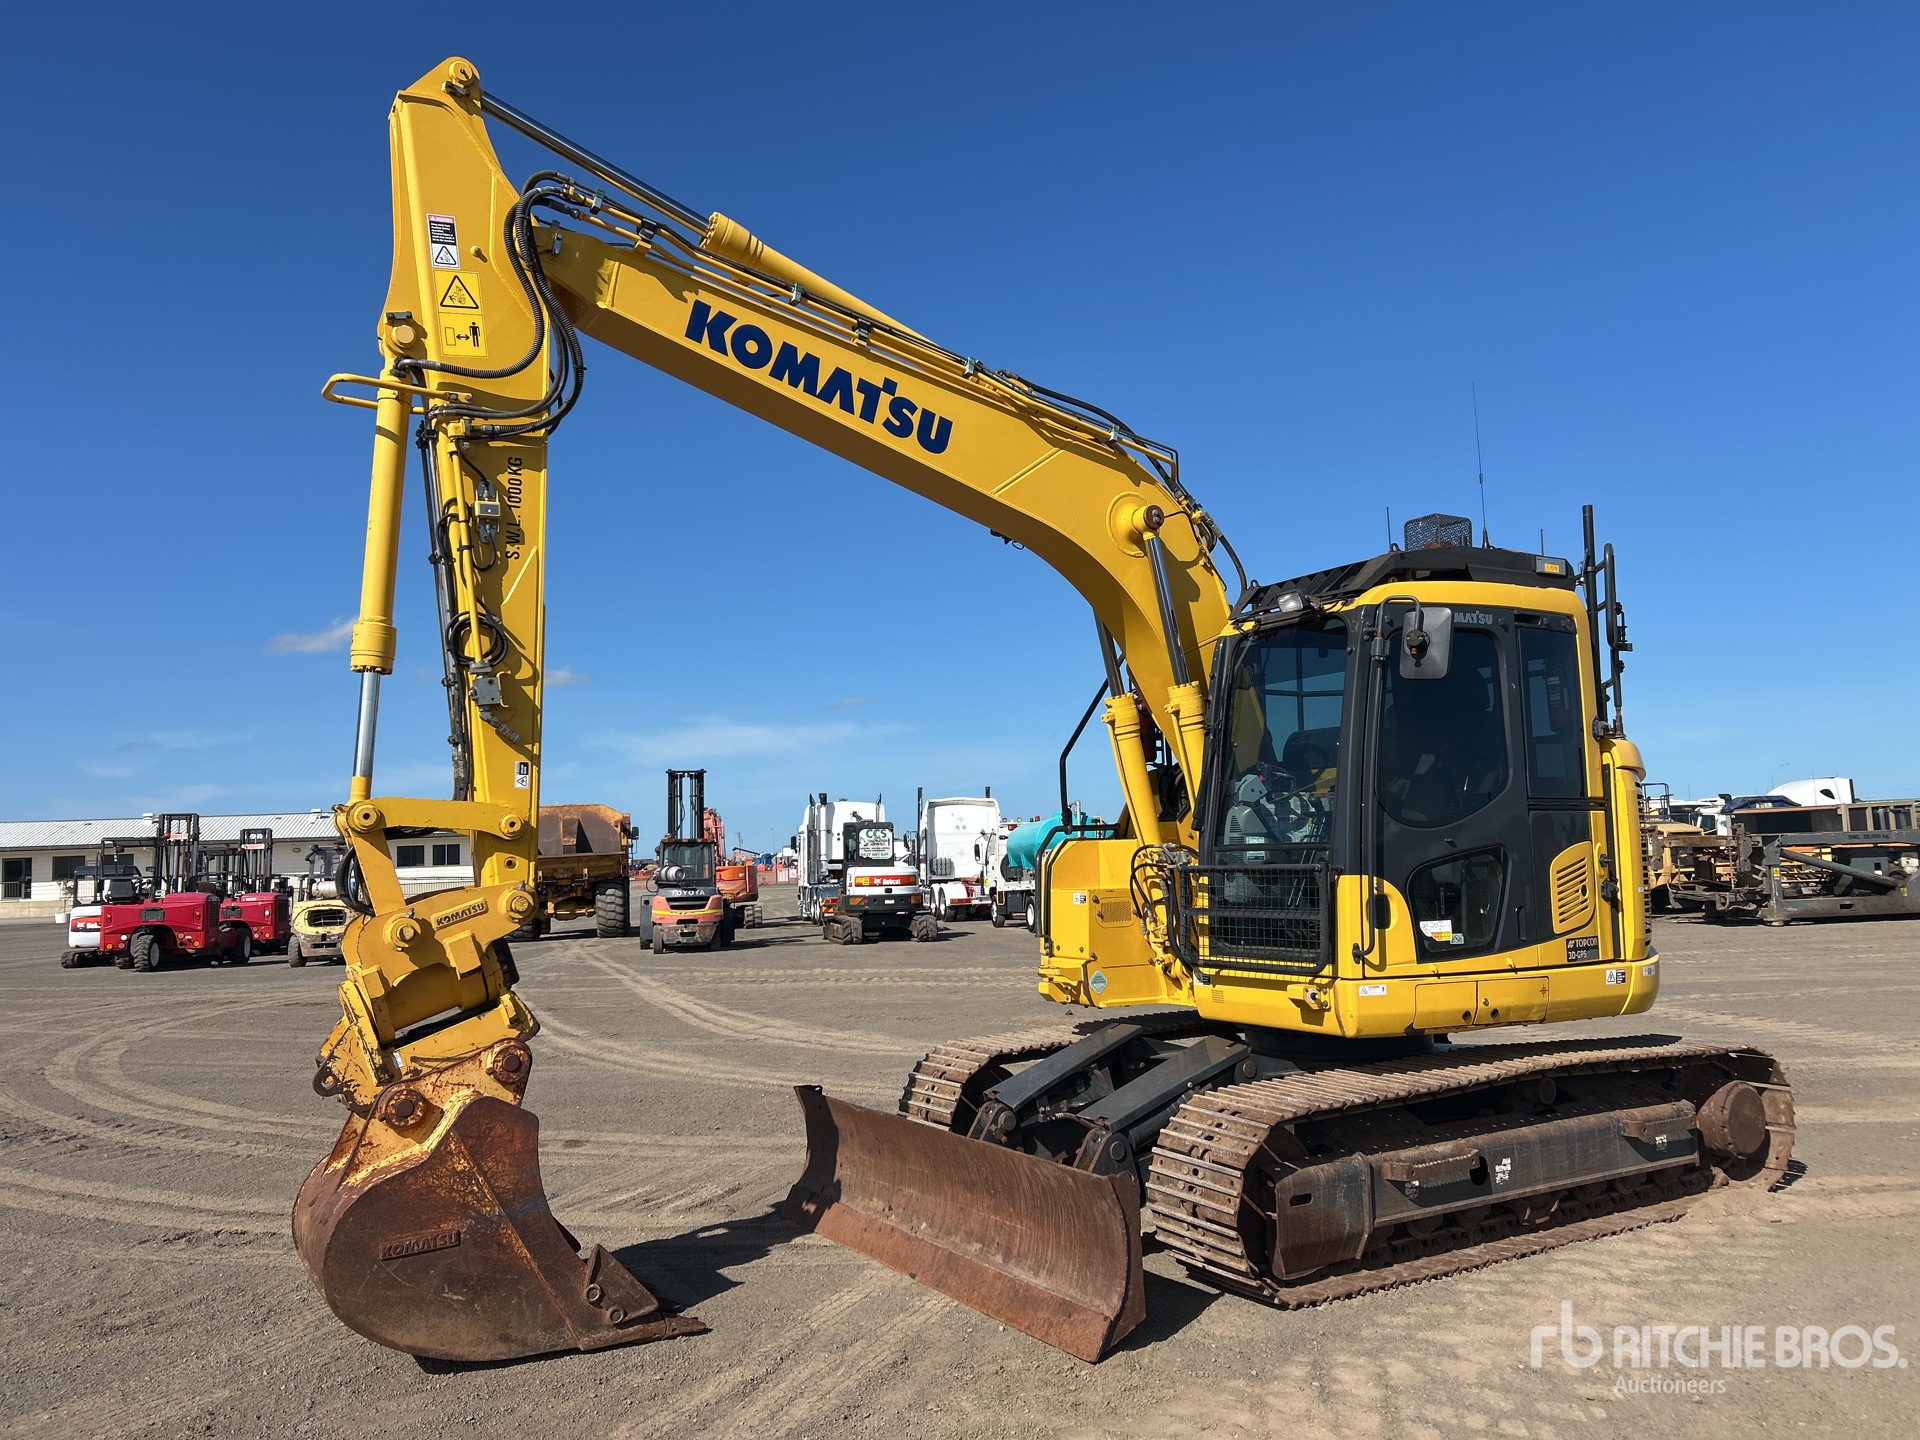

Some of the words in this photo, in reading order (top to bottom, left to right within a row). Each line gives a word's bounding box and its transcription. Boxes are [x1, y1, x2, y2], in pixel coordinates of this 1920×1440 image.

[684, 299, 953, 454] KOMATSU
[1453, 610, 1493, 625] MATSU
[672, 889, 706, 897] TOYOTA
[436, 902, 486, 926] KOMATSU
[381, 1232, 459, 1258] KOMATSU
